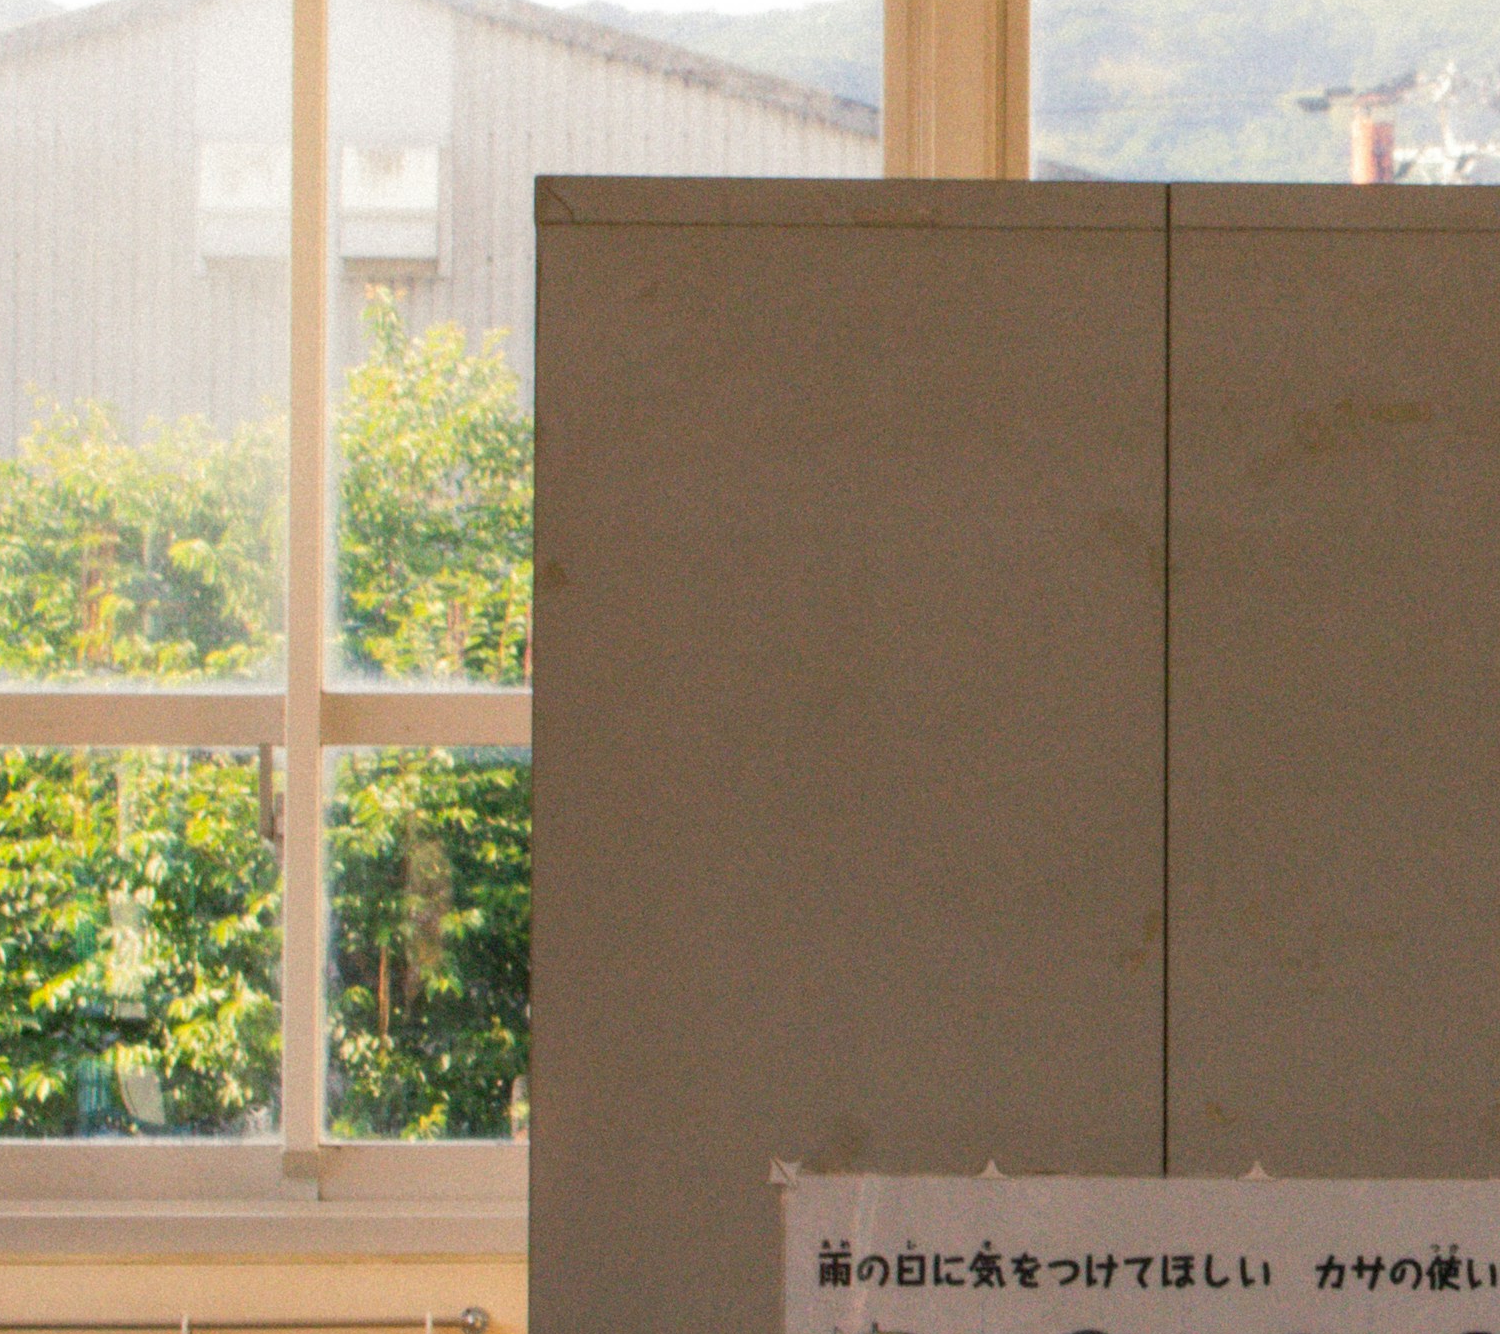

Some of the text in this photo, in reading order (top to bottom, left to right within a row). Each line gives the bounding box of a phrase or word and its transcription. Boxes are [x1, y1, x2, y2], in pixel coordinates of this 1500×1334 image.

[817, 1250, 1272, 1289] 雨の日に気をつけてほしい
